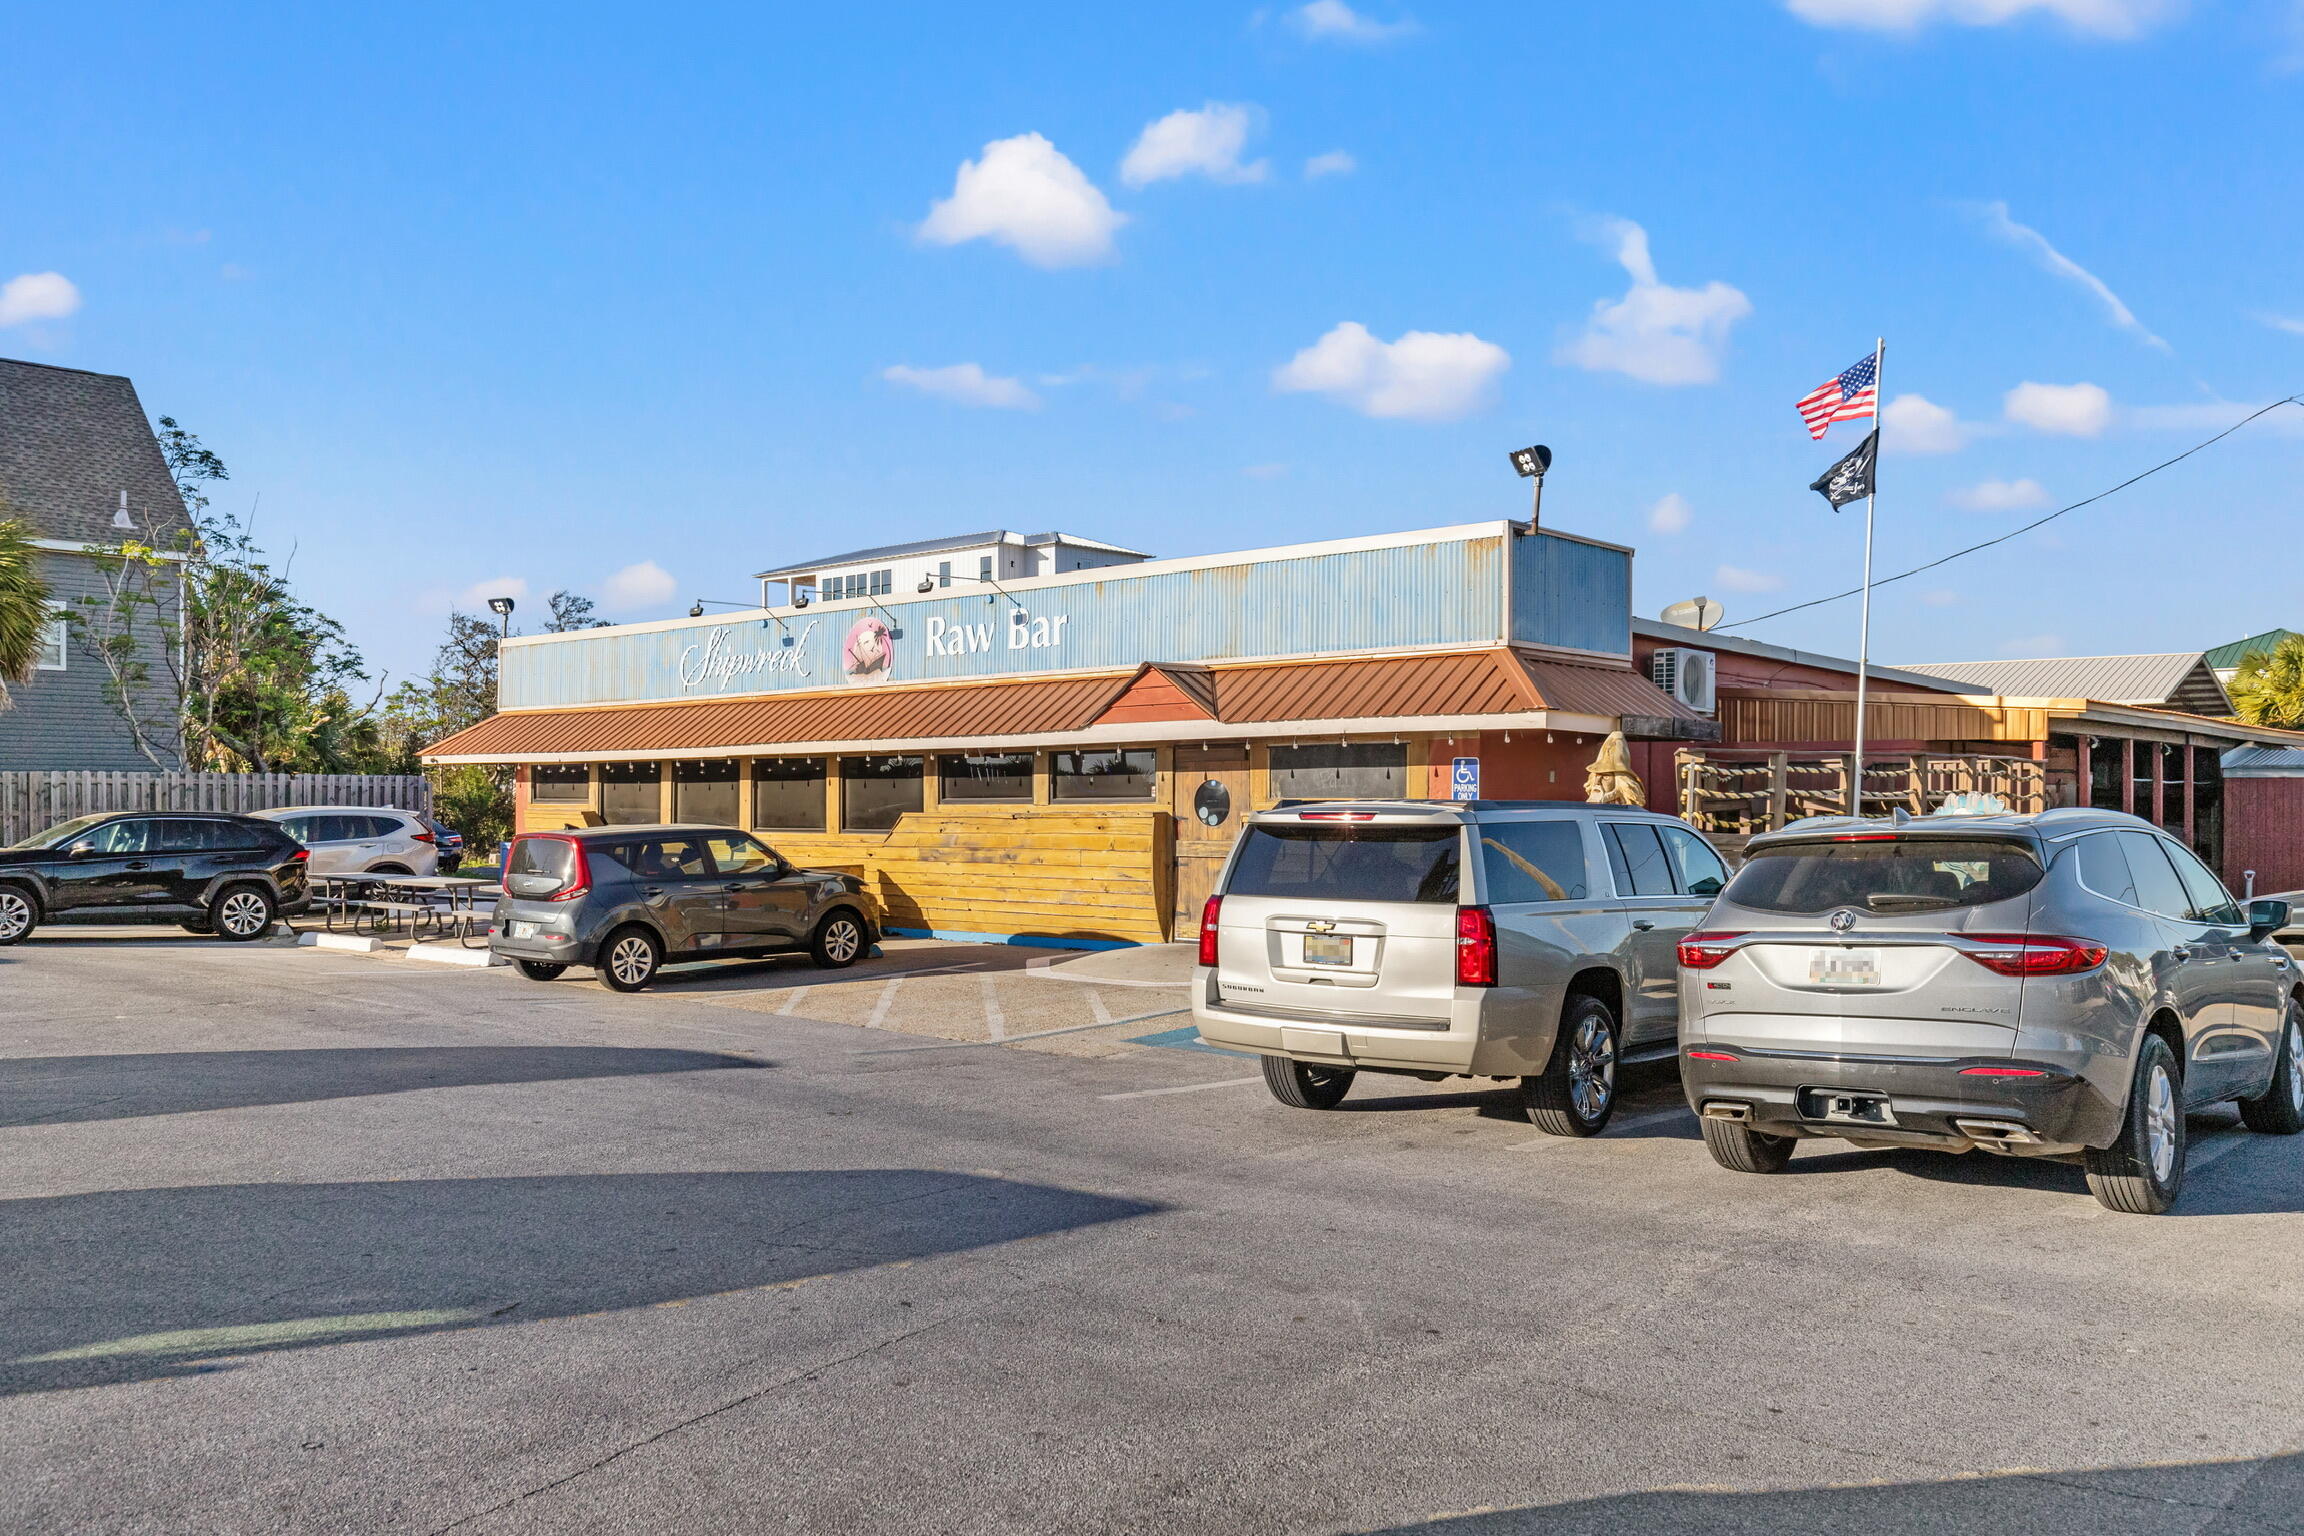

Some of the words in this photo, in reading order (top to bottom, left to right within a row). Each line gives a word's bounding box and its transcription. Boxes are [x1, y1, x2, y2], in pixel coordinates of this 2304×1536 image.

[680, 620, 820, 692] Shipwreck
[926, 616, 995, 656] Raw
[1007, 607, 1069, 650] Bar
[1454, 783, 1477, 793] PARKING
[1457, 791, 1473, 800] ONLY
